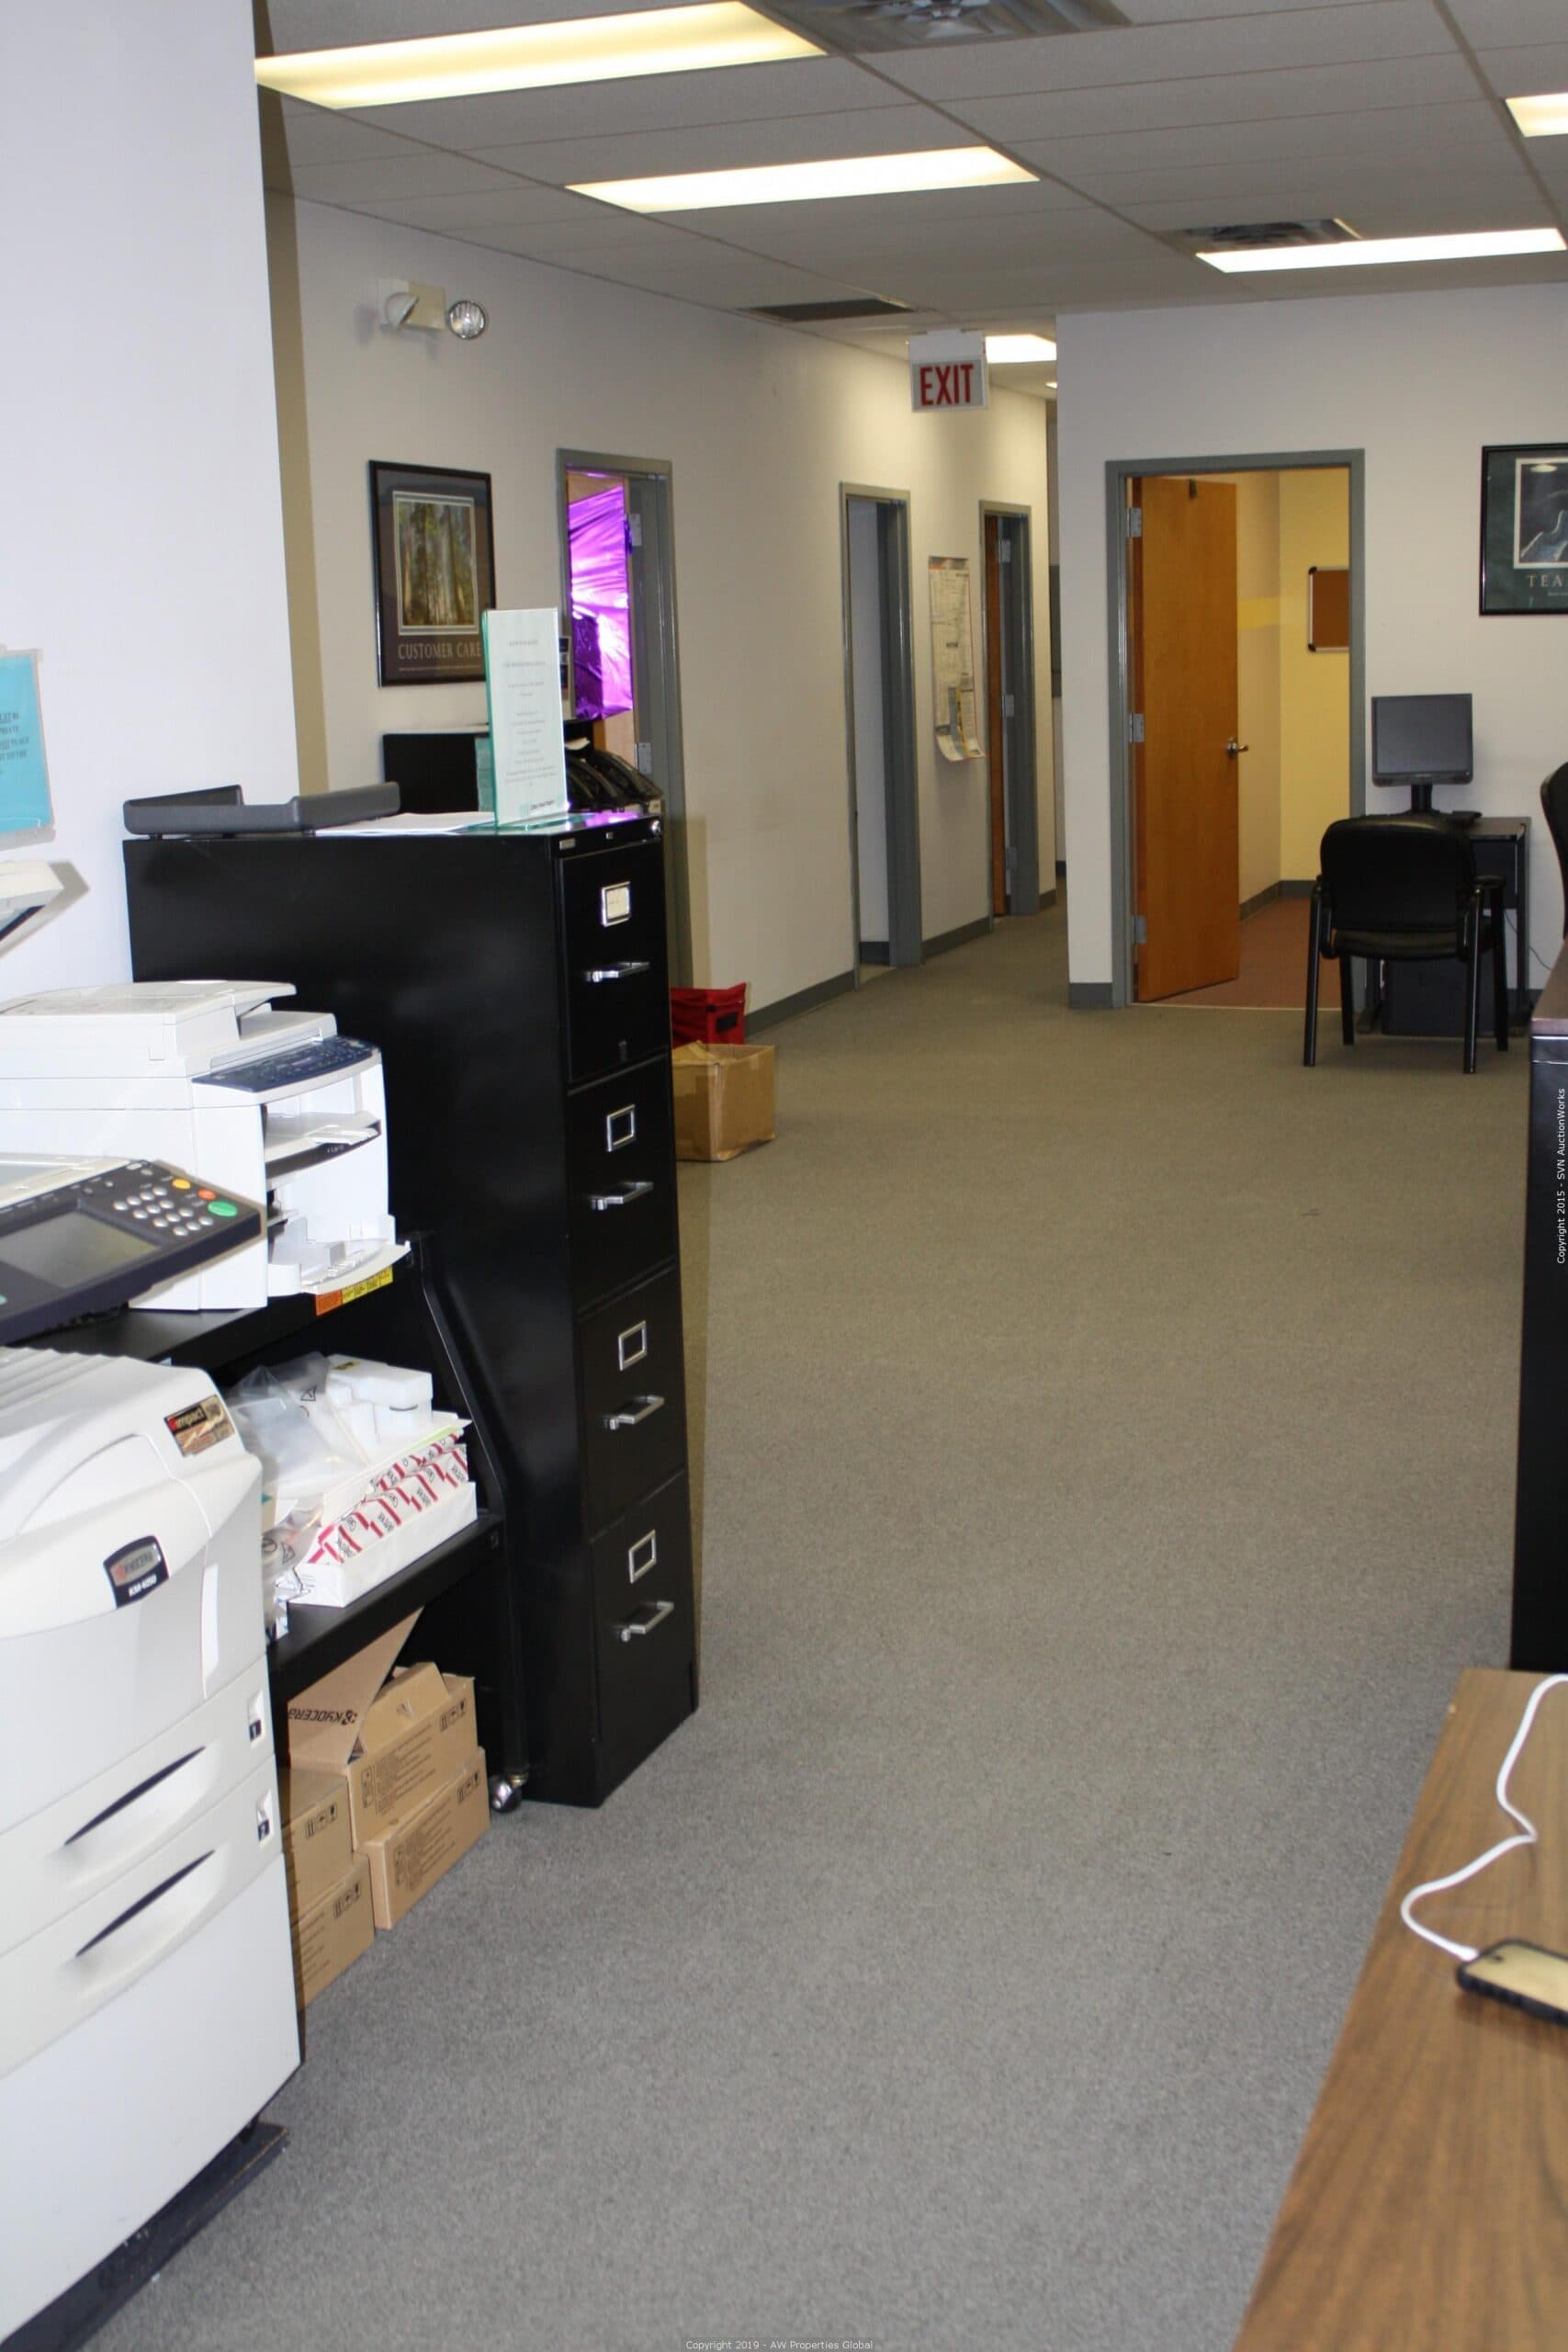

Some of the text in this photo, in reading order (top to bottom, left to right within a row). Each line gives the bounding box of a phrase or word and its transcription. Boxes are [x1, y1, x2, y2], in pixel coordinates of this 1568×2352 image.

[919, 364, 975, 406] EXIT
[398, 641, 481, 660] CUSTOMER CARE
